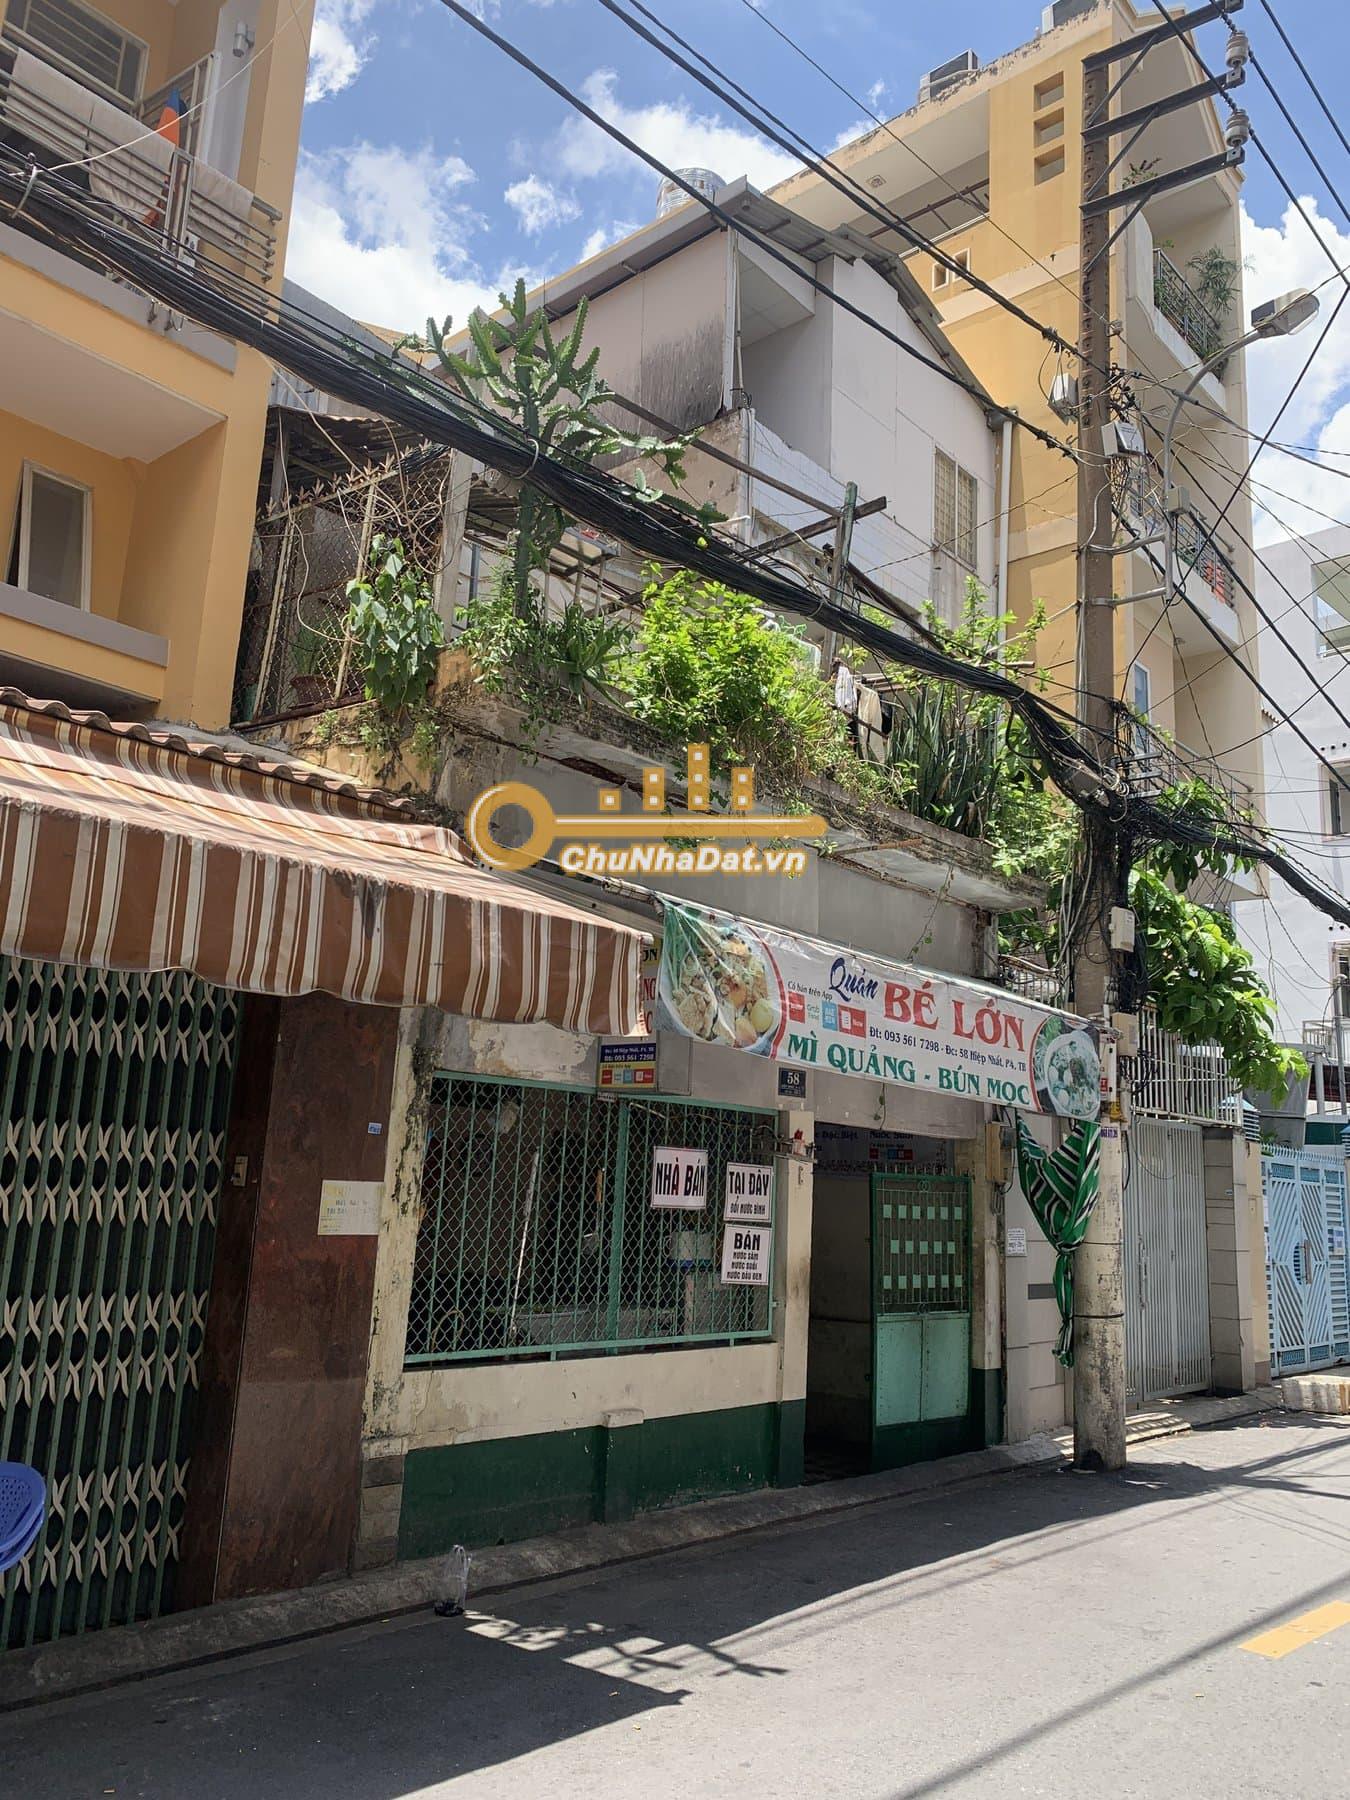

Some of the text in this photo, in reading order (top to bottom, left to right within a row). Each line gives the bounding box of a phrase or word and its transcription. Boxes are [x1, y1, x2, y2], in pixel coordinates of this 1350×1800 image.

[821, 991, 833, 1003] App
[883, 979, 1025, 1052] BÉ LỚN
[869, 1026, 882, 1039] Đt:
[884, 1029, 901, 1043] 093
[902, 1034, 917, 1048] 561
[919, 1038, 940, 1053] 7298
[959, 1048, 969, 1060] 58
[787, 1072, 800, 1086] 58
[788, 1030, 819, 1064] MÌ
[827, 1044, 916, 1083] QUẢNG
[937, 1064, 981, 1096] BÚN
[987, 1077, 1031, 1107] MỌC
[655, 1156, 706, 1197] NHÀ BÁN
[734, 1230, 760, 1251] BÁN
